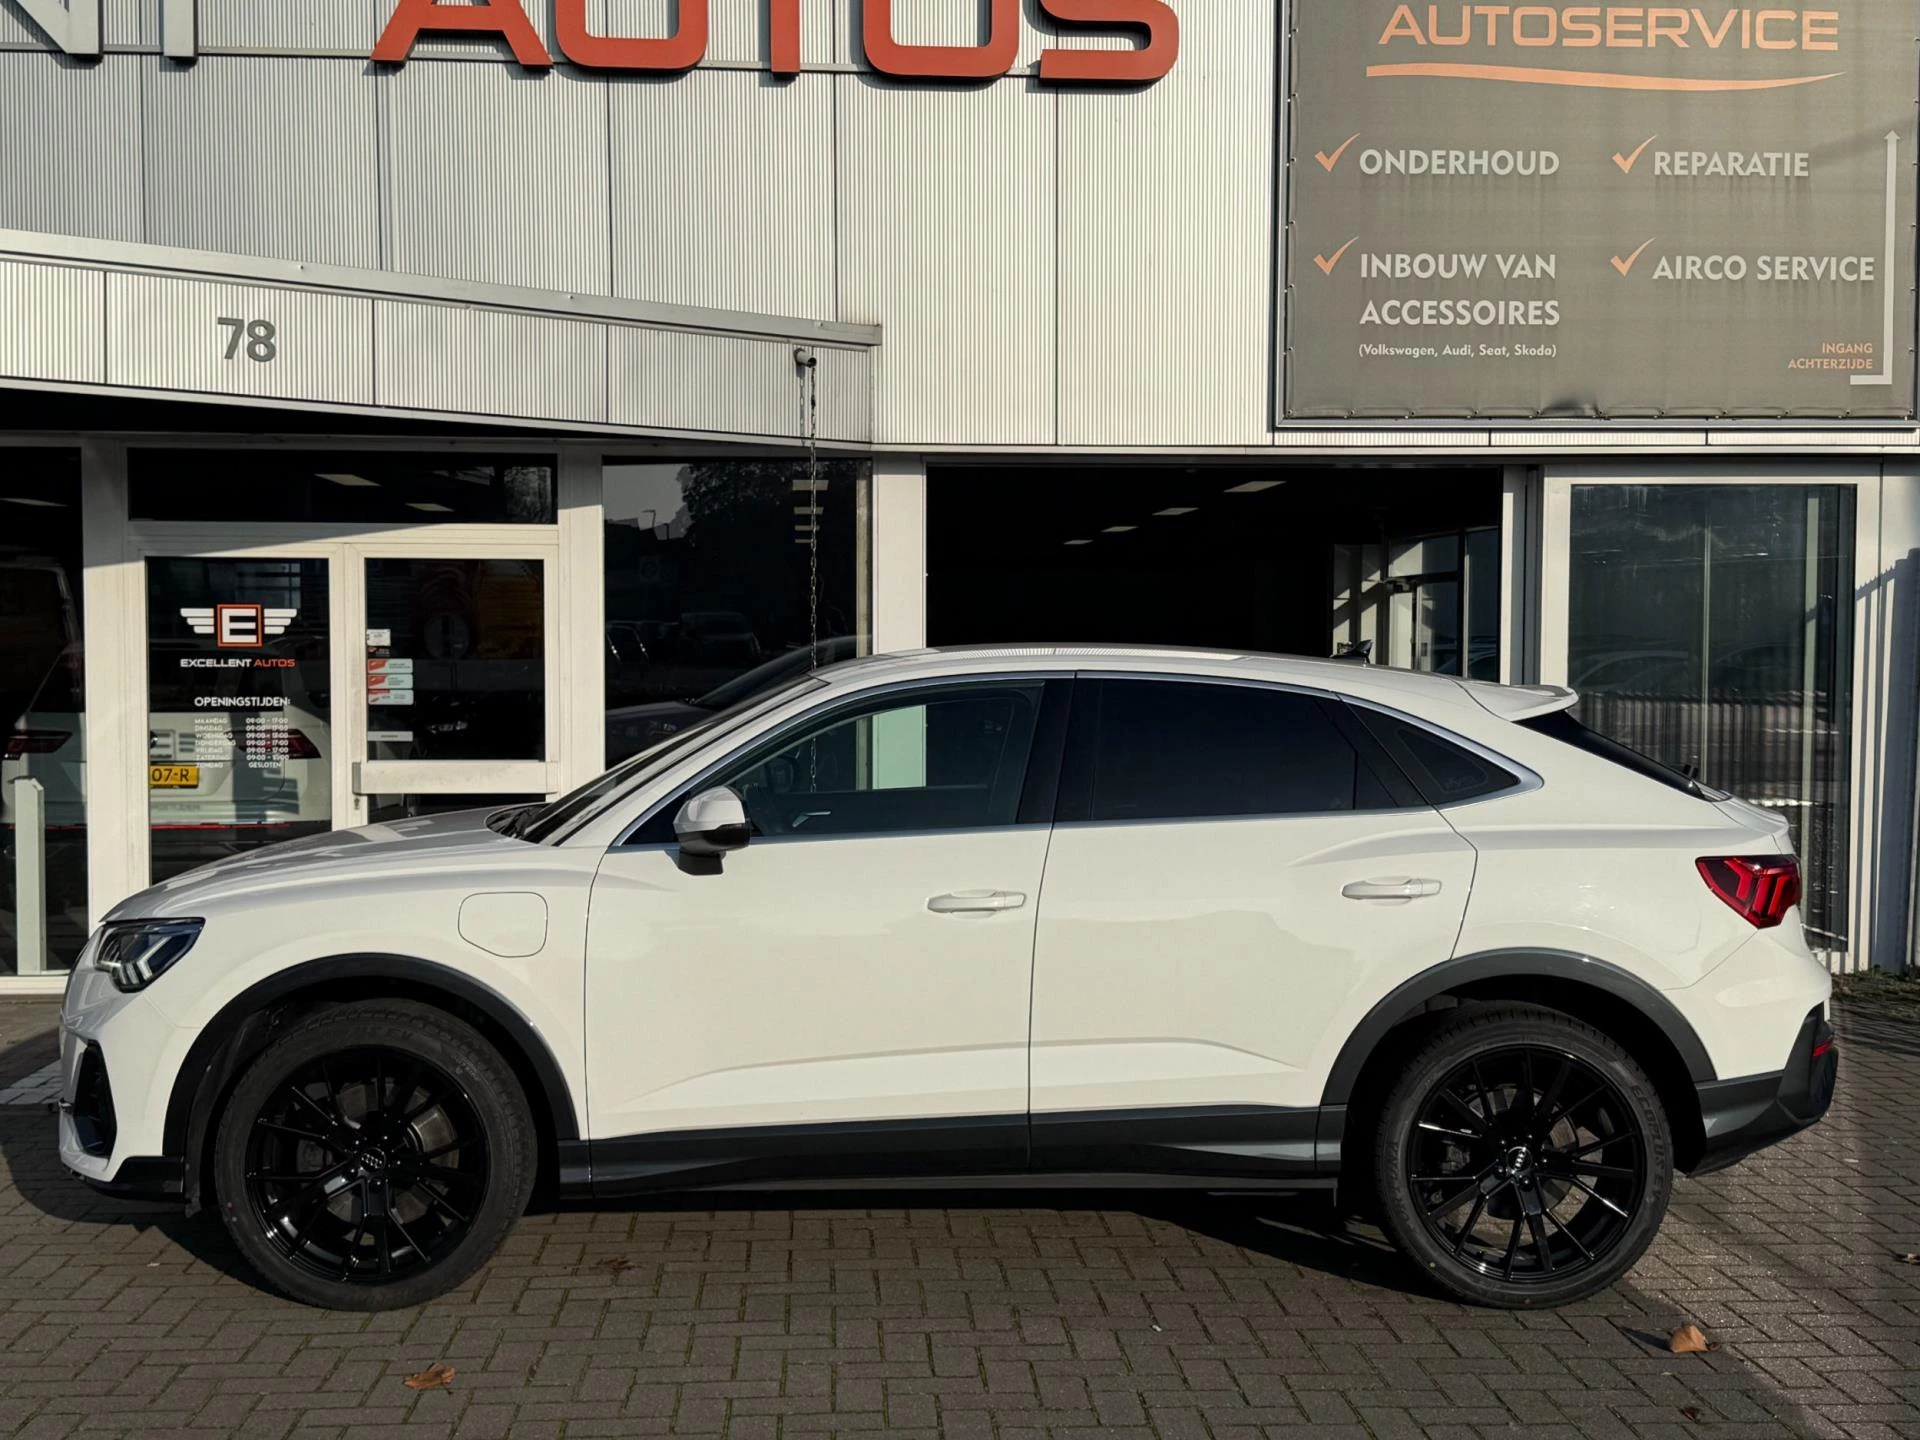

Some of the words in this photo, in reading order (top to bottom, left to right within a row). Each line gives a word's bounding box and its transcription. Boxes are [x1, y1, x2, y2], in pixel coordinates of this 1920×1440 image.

[1378, 5, 1840, 51] AUTOSERVICE
[1359, 148, 1560, 177] ONDERHOUD
[1653, 150, 1810, 178] REPARATIE
[1360, 253, 1488, 281] INBOUW
[1495, 254, 1557, 280] VAN
[1652, 256, 1748, 282] AIRCO
[1756, 256, 1875, 282] SERVICE
[1359, 300, 1561, 327] ACCESSOIRES
[217, 317, 277, 363] 78
[1358, 344, 1439, 359] (Volkswagen,
[1442, 344, 1475, 358] Audi,
[1479, 345, 1511, 358] Seat,
[1513, 344, 1557, 359] Skoda)
[1821, 342, 1874, 355] INGANG
[1787, 358, 1874, 371] ACHTERZIJDE
[180, 658, 252, 668] EXCELLENT
[253, 658, 296, 668] AUTOS
[194, 696, 291, 707] OPENINGSTIJDEN:
